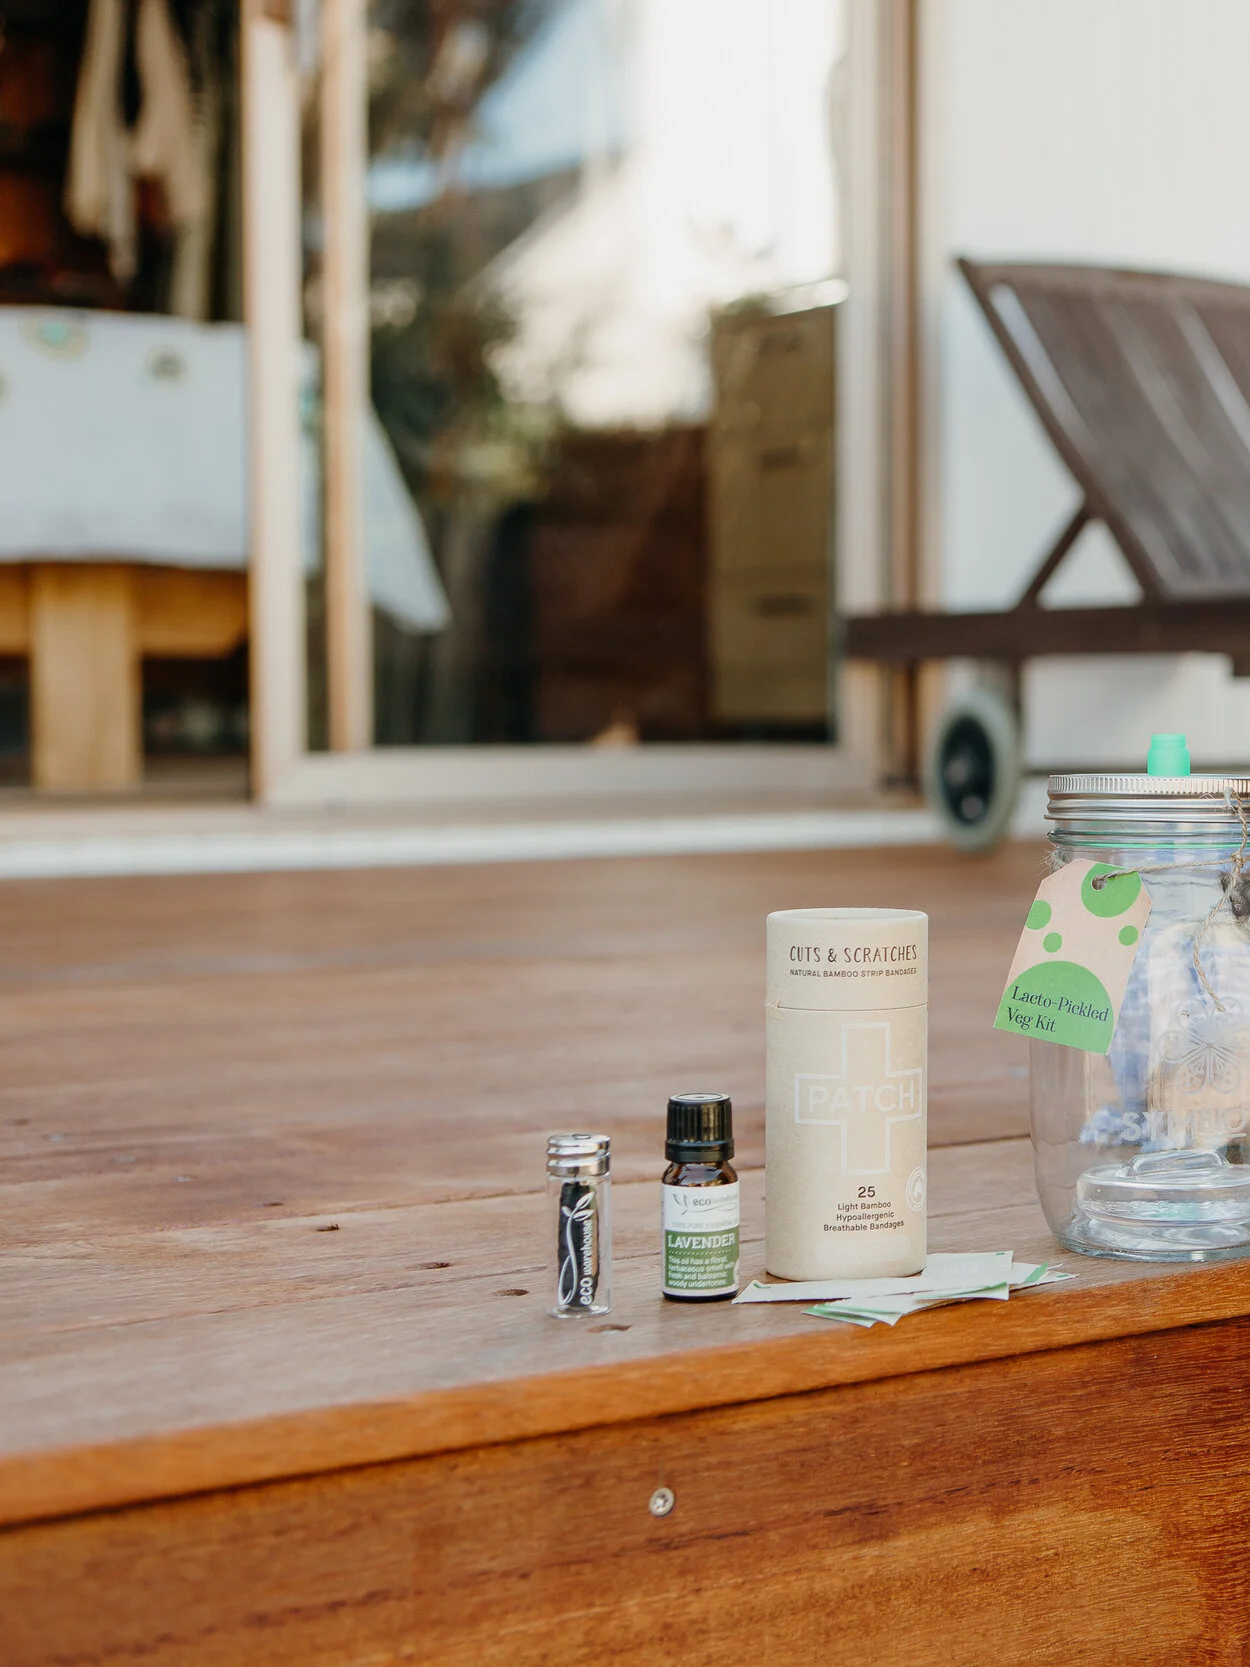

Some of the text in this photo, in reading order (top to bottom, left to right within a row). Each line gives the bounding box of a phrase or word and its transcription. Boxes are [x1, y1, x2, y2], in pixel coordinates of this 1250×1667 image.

[790, 944, 917, 963] CUTS & SCRATCHES
[790, 967, 917, 978] NATURAL BAMBOO STRIP BANDAGES
[1012, 985, 1109, 1022] Lacto-Pickled
[1007, 1006, 1057, 1033] Veg Kit
[809, 1080, 915, 1113] PATCH
[857, 1186, 876, 1198] 25
[837, 1201, 892, 1212] Light Bamboo
[836, 1211, 895, 1222] Hypoallergenic
[823, 1220, 905, 1232] Breathable Bandages
[667, 1232, 735, 1249] LAVENDER
[580, 1219, 593, 1305] eco warehouse
